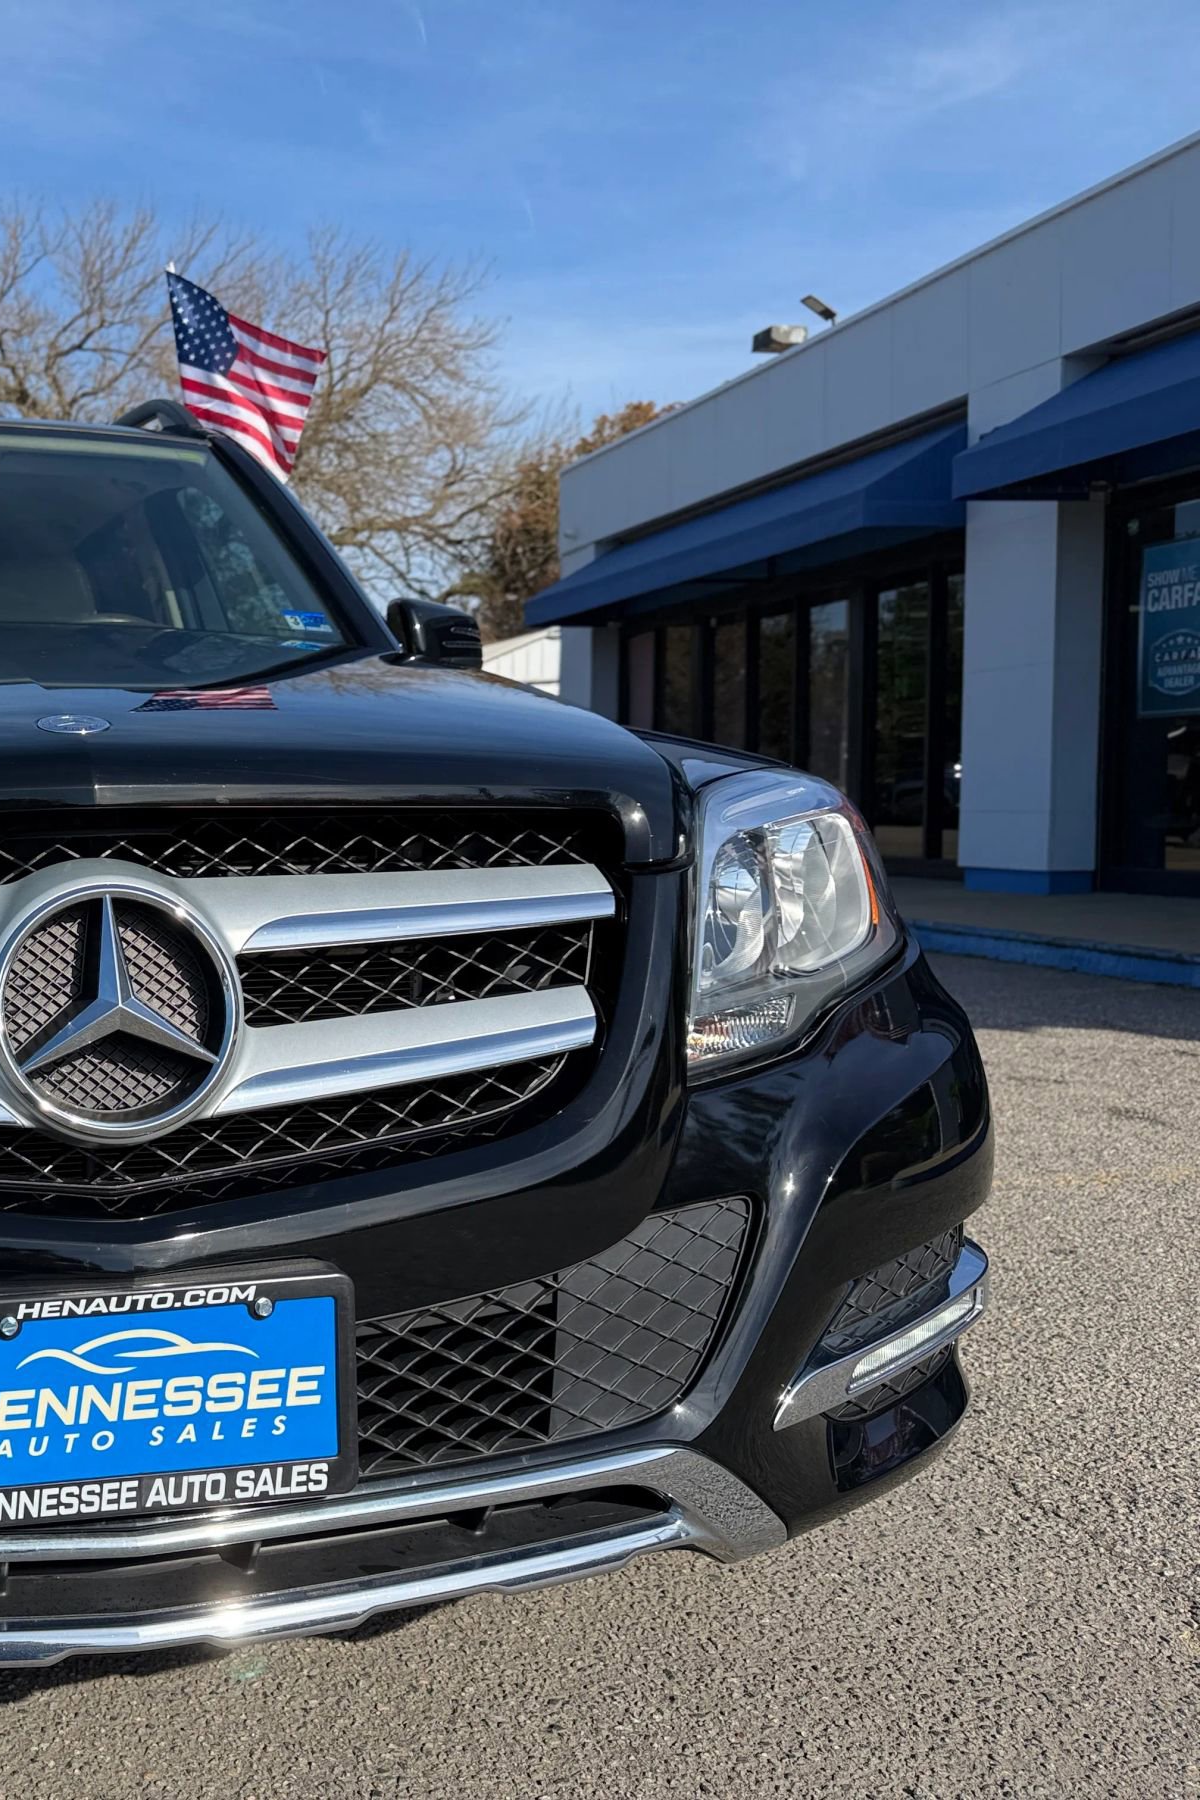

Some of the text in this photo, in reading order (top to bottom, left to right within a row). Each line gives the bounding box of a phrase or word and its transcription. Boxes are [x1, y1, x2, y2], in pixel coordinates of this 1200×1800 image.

[1147, 568, 1180, 587] SHOW
[1164, 675, 1194, 688] DEALER
[17, 1285, 256, 1320] HENAUTO.COM
[149, 1415, 287, 1447] SALES
[145, 1472, 226, 1508] AUTO
[234, 1463, 329, 1497] SALES
